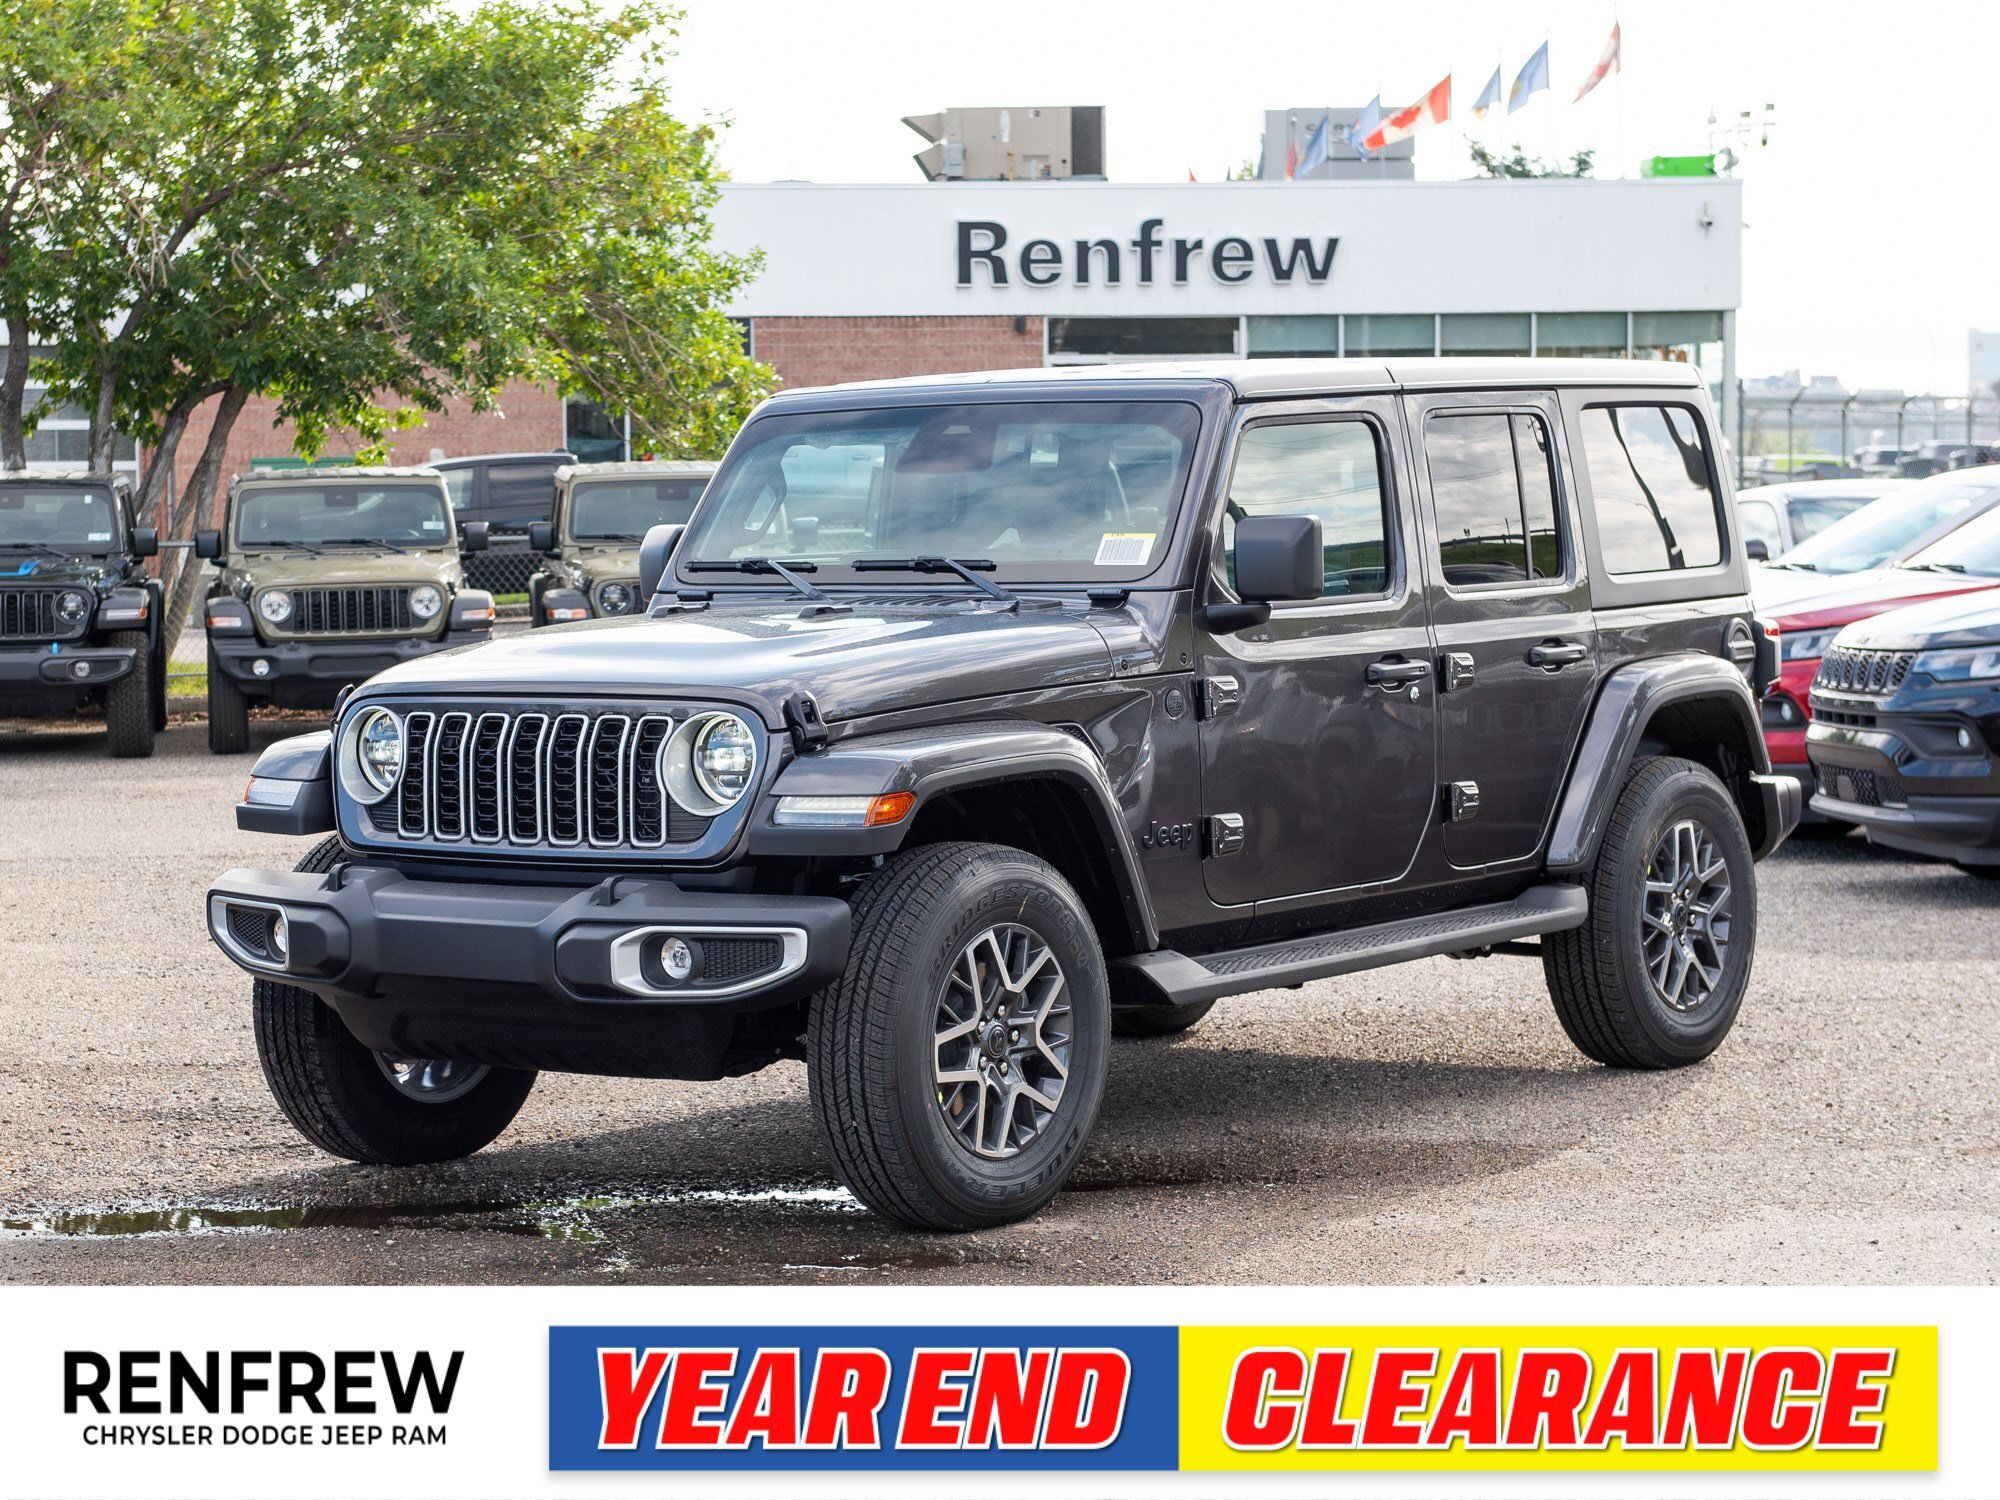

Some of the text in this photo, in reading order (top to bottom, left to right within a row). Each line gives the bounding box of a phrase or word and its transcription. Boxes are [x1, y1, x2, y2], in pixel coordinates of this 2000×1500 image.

[957, 219, 1340, 286] Renfrew
[1142, 820, 1195, 850] Jeep
[926, 881, 1078, 988] BRIDGESTONE
[964, 1122, 1080, 1200] DUELER
